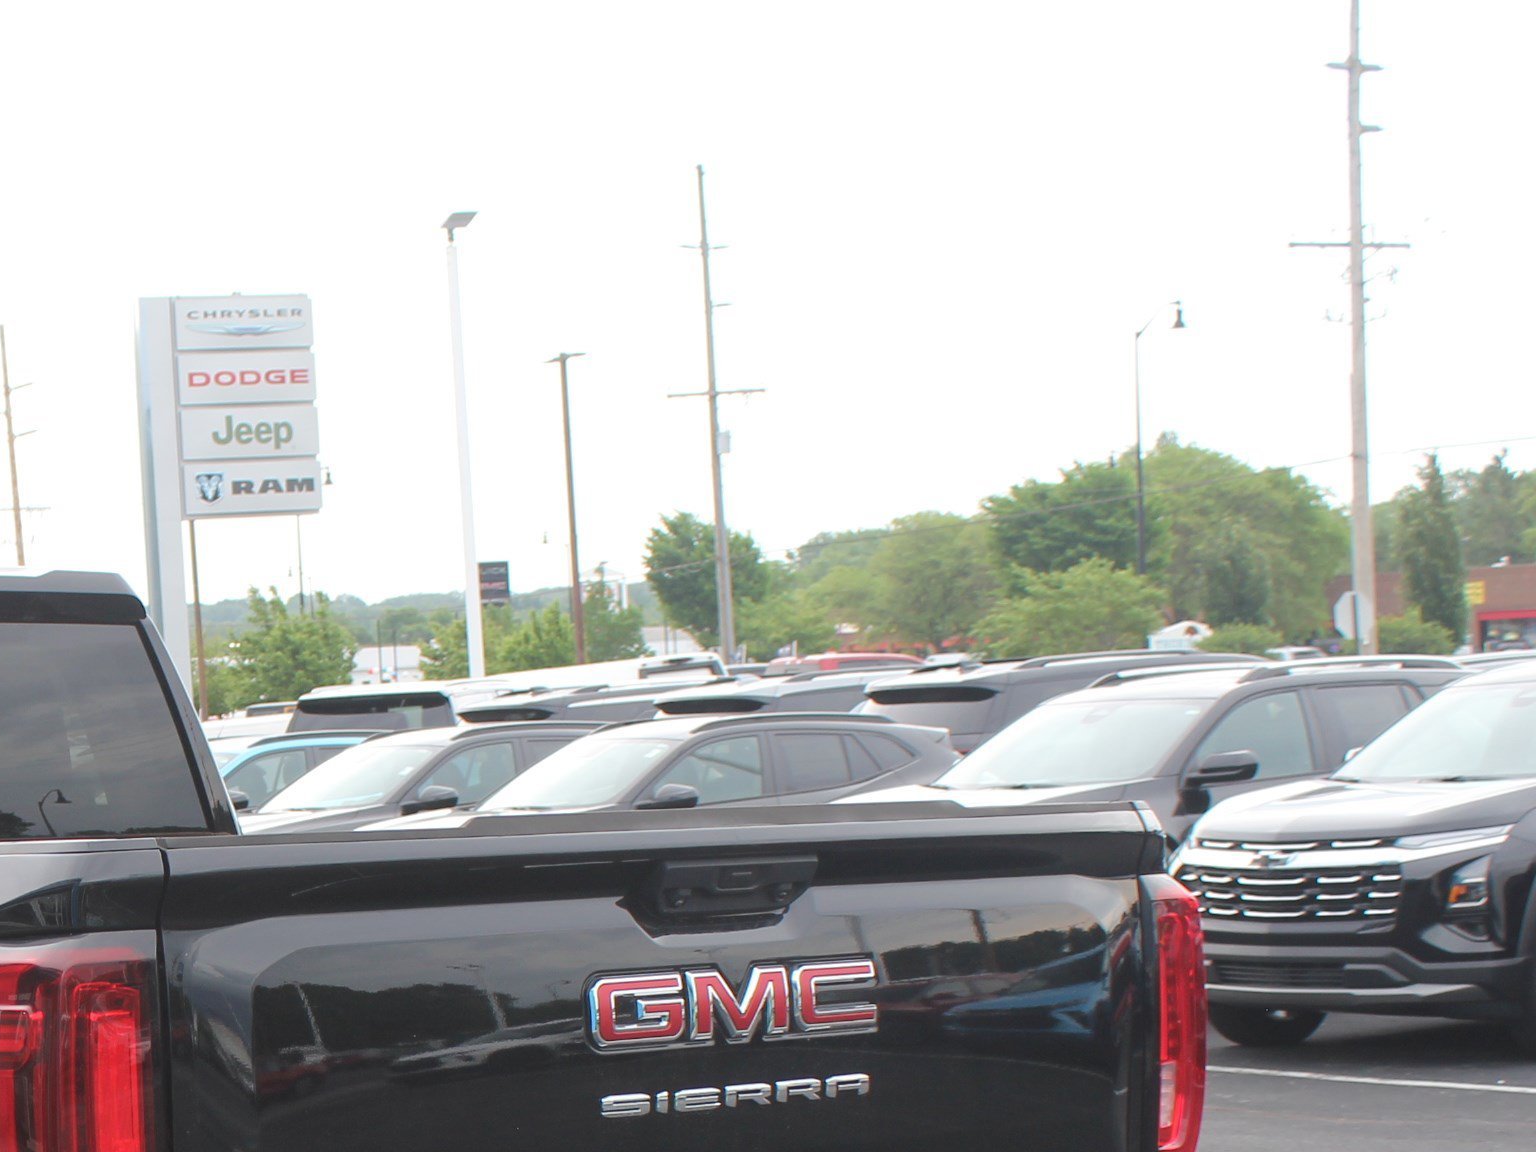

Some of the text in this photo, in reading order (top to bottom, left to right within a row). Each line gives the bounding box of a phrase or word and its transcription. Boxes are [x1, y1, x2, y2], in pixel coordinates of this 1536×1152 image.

[186, 308, 303, 320] CHRYSLER
[187, 368, 309, 387] DODGE
[211, 415, 294, 449] Jeep
[231, 477, 315, 495] RAM
[588, 960, 878, 1051] GMC
[601, 1073, 870, 1118] SIERRA
